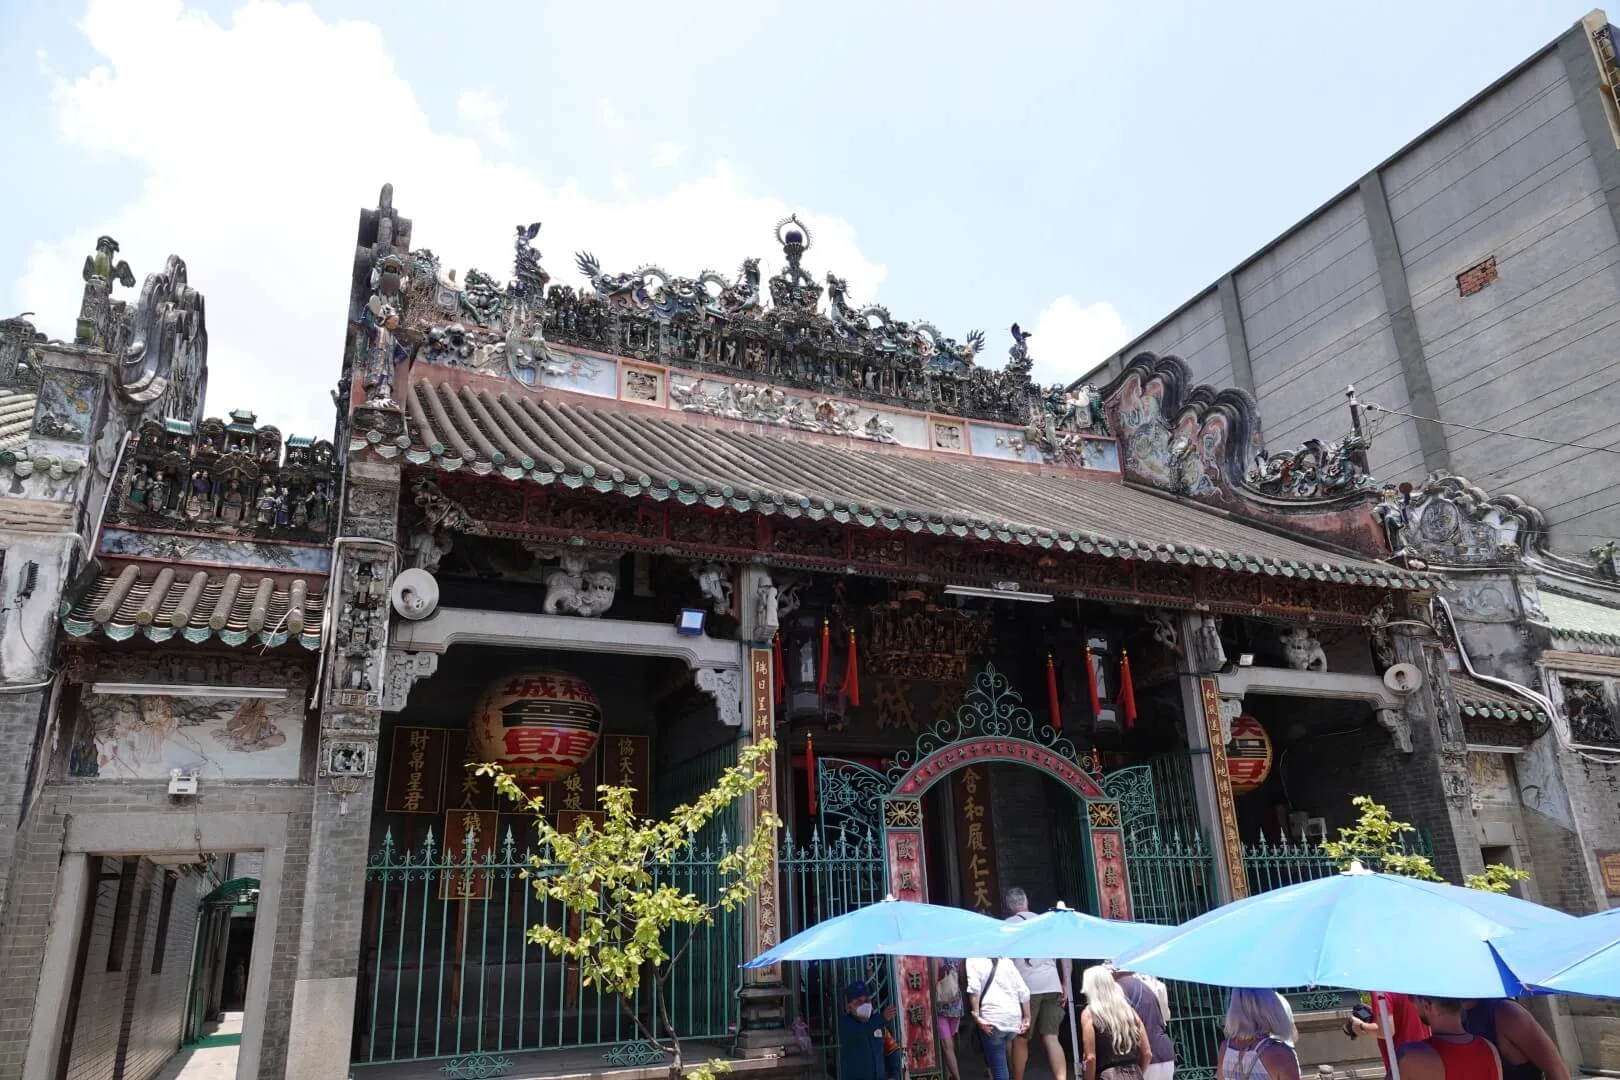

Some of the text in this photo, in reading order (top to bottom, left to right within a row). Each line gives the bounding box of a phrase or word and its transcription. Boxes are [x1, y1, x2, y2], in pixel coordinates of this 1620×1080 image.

[402, 729, 430, 811] 財帛星君
[562, 772, 584, 811] 娘娘
[961, 767, 993, 909] 含和履仁天
